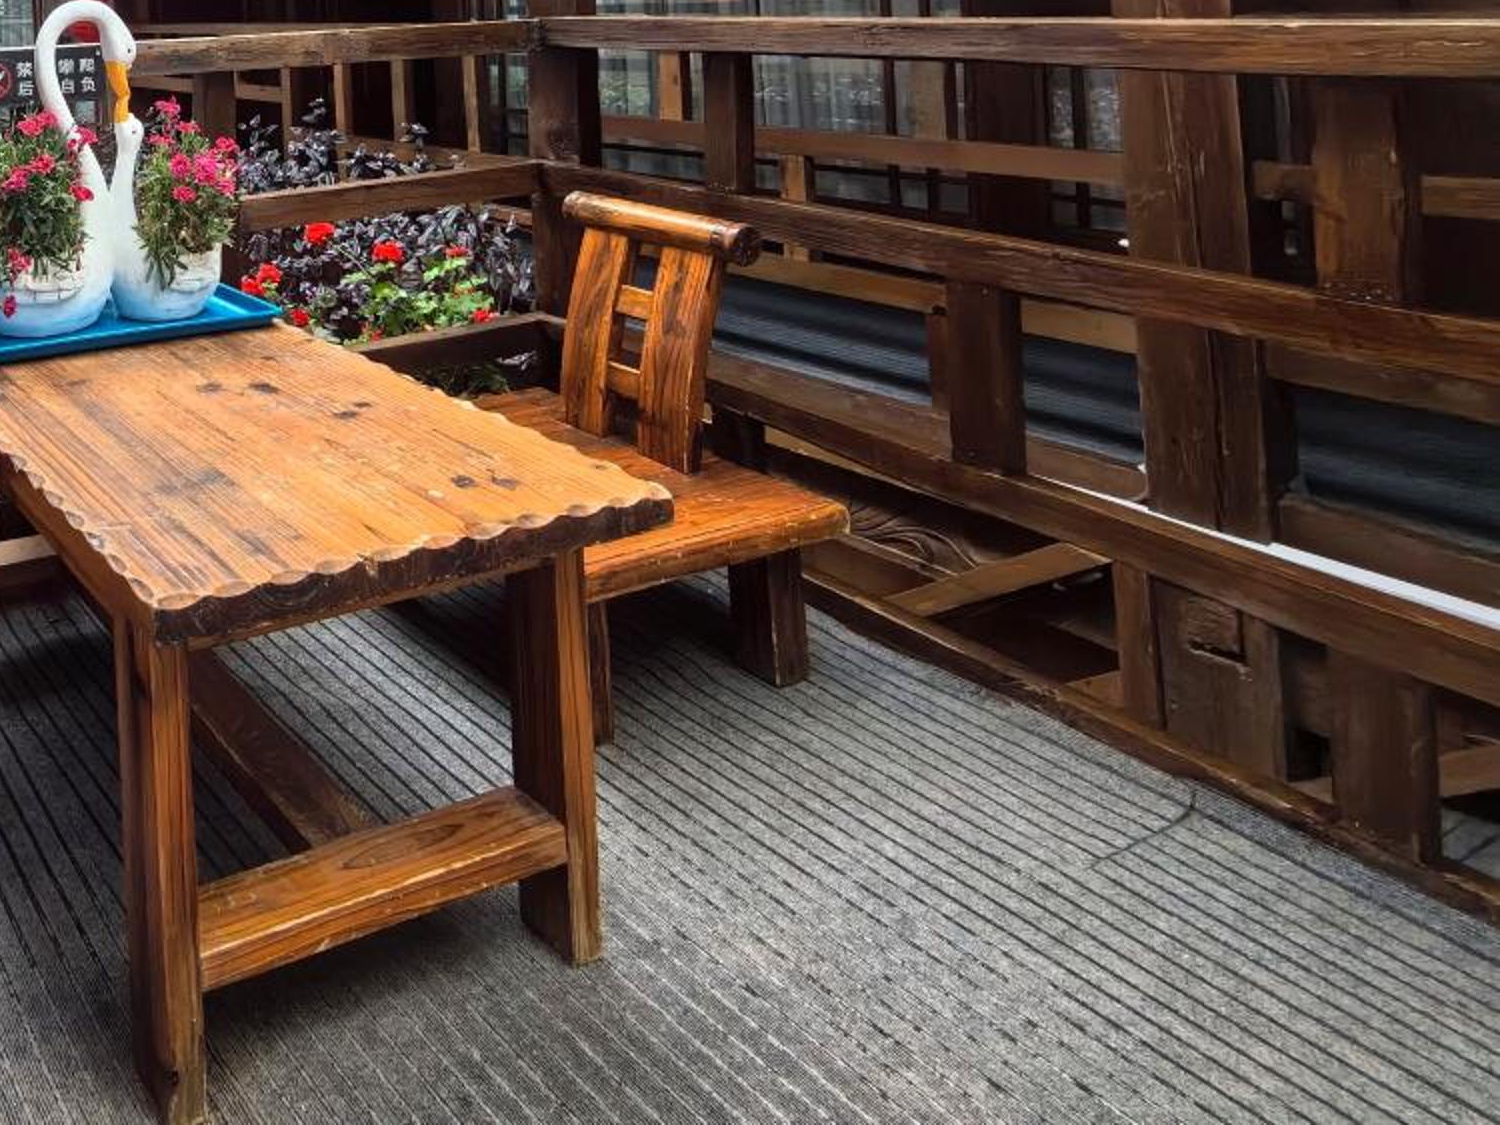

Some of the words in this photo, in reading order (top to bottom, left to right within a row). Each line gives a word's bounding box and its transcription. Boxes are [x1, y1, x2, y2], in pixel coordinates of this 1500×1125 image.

[16, 58, 95, 78] 禁攀爬
[18, 76, 96, 97] 后自负
